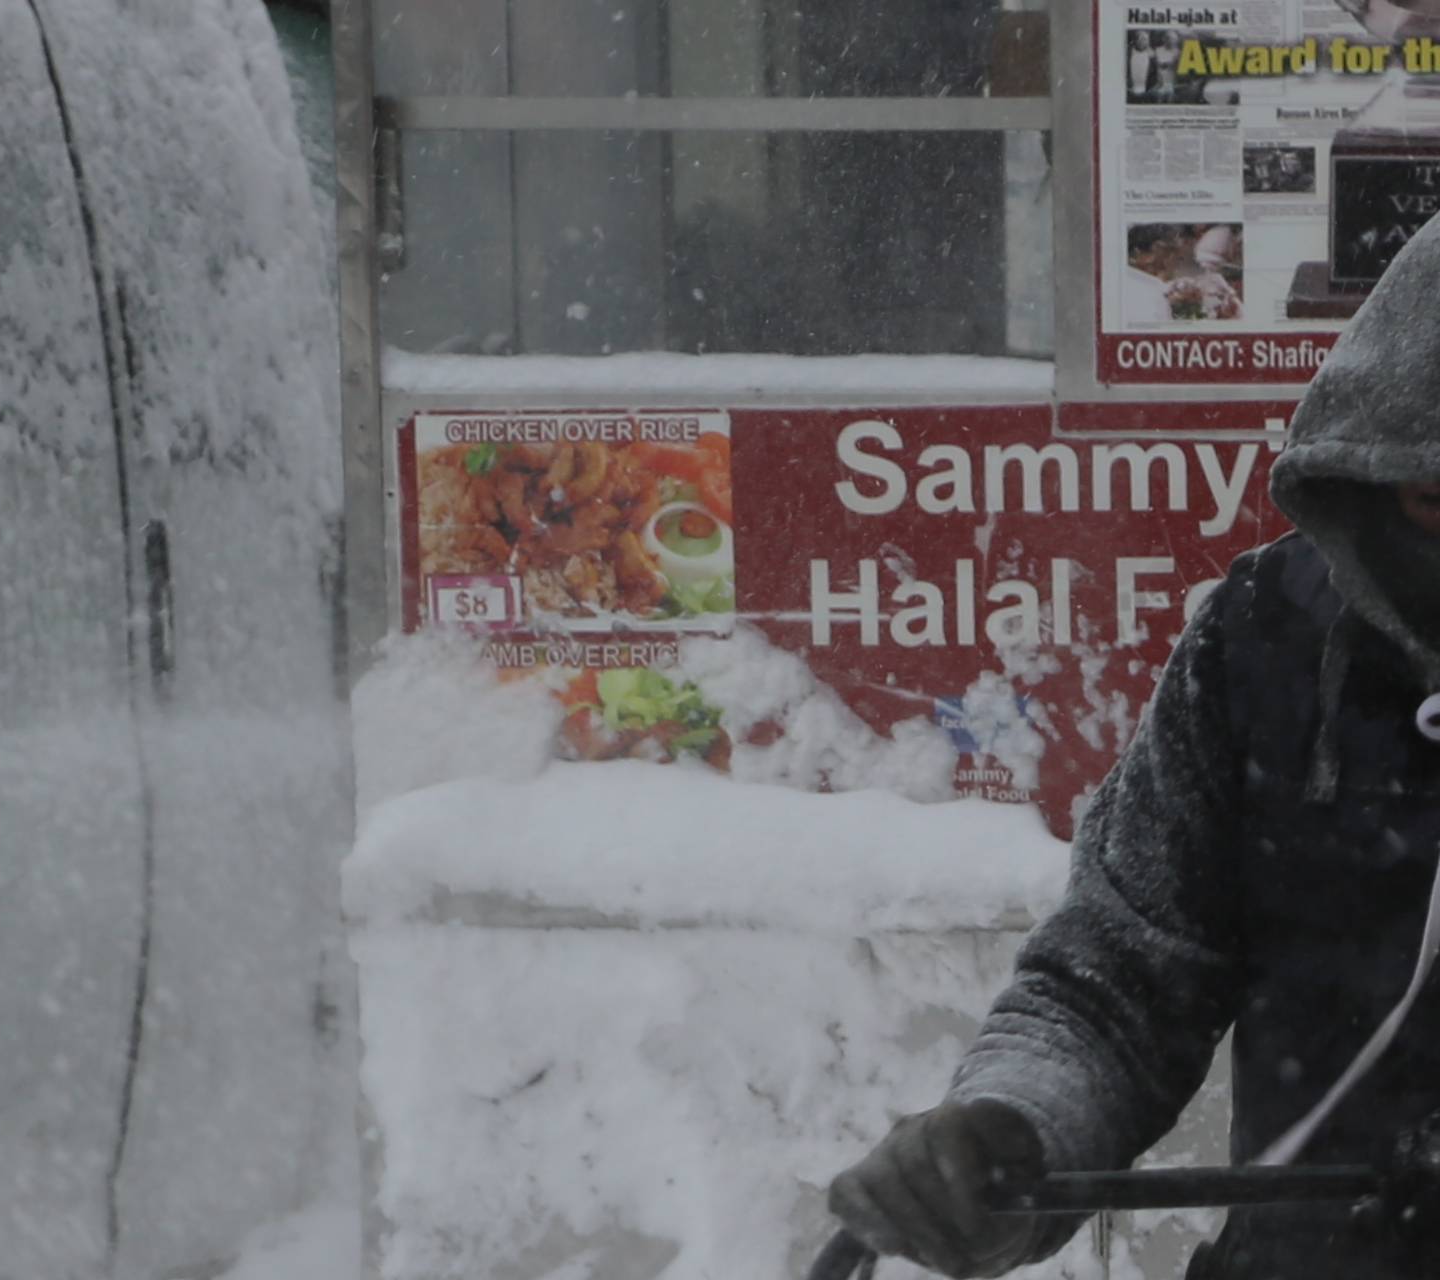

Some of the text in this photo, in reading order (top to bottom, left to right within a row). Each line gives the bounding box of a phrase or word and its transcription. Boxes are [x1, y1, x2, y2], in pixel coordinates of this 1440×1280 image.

[1220, 9, 1238, 24] at
[1177, 38, 1316, 75] Award
[1330, 36, 1390, 73] for
[1116, 340, 1244, 369] CONTACT:
[445, 418, 700, 443] CHICKEN OVER RICE
[454, 594, 489, 618] $8
[808, 557, 1072, 651] Halal
[482, 640, 537, 667] AMB
[545, 640, 625, 668] OVER
